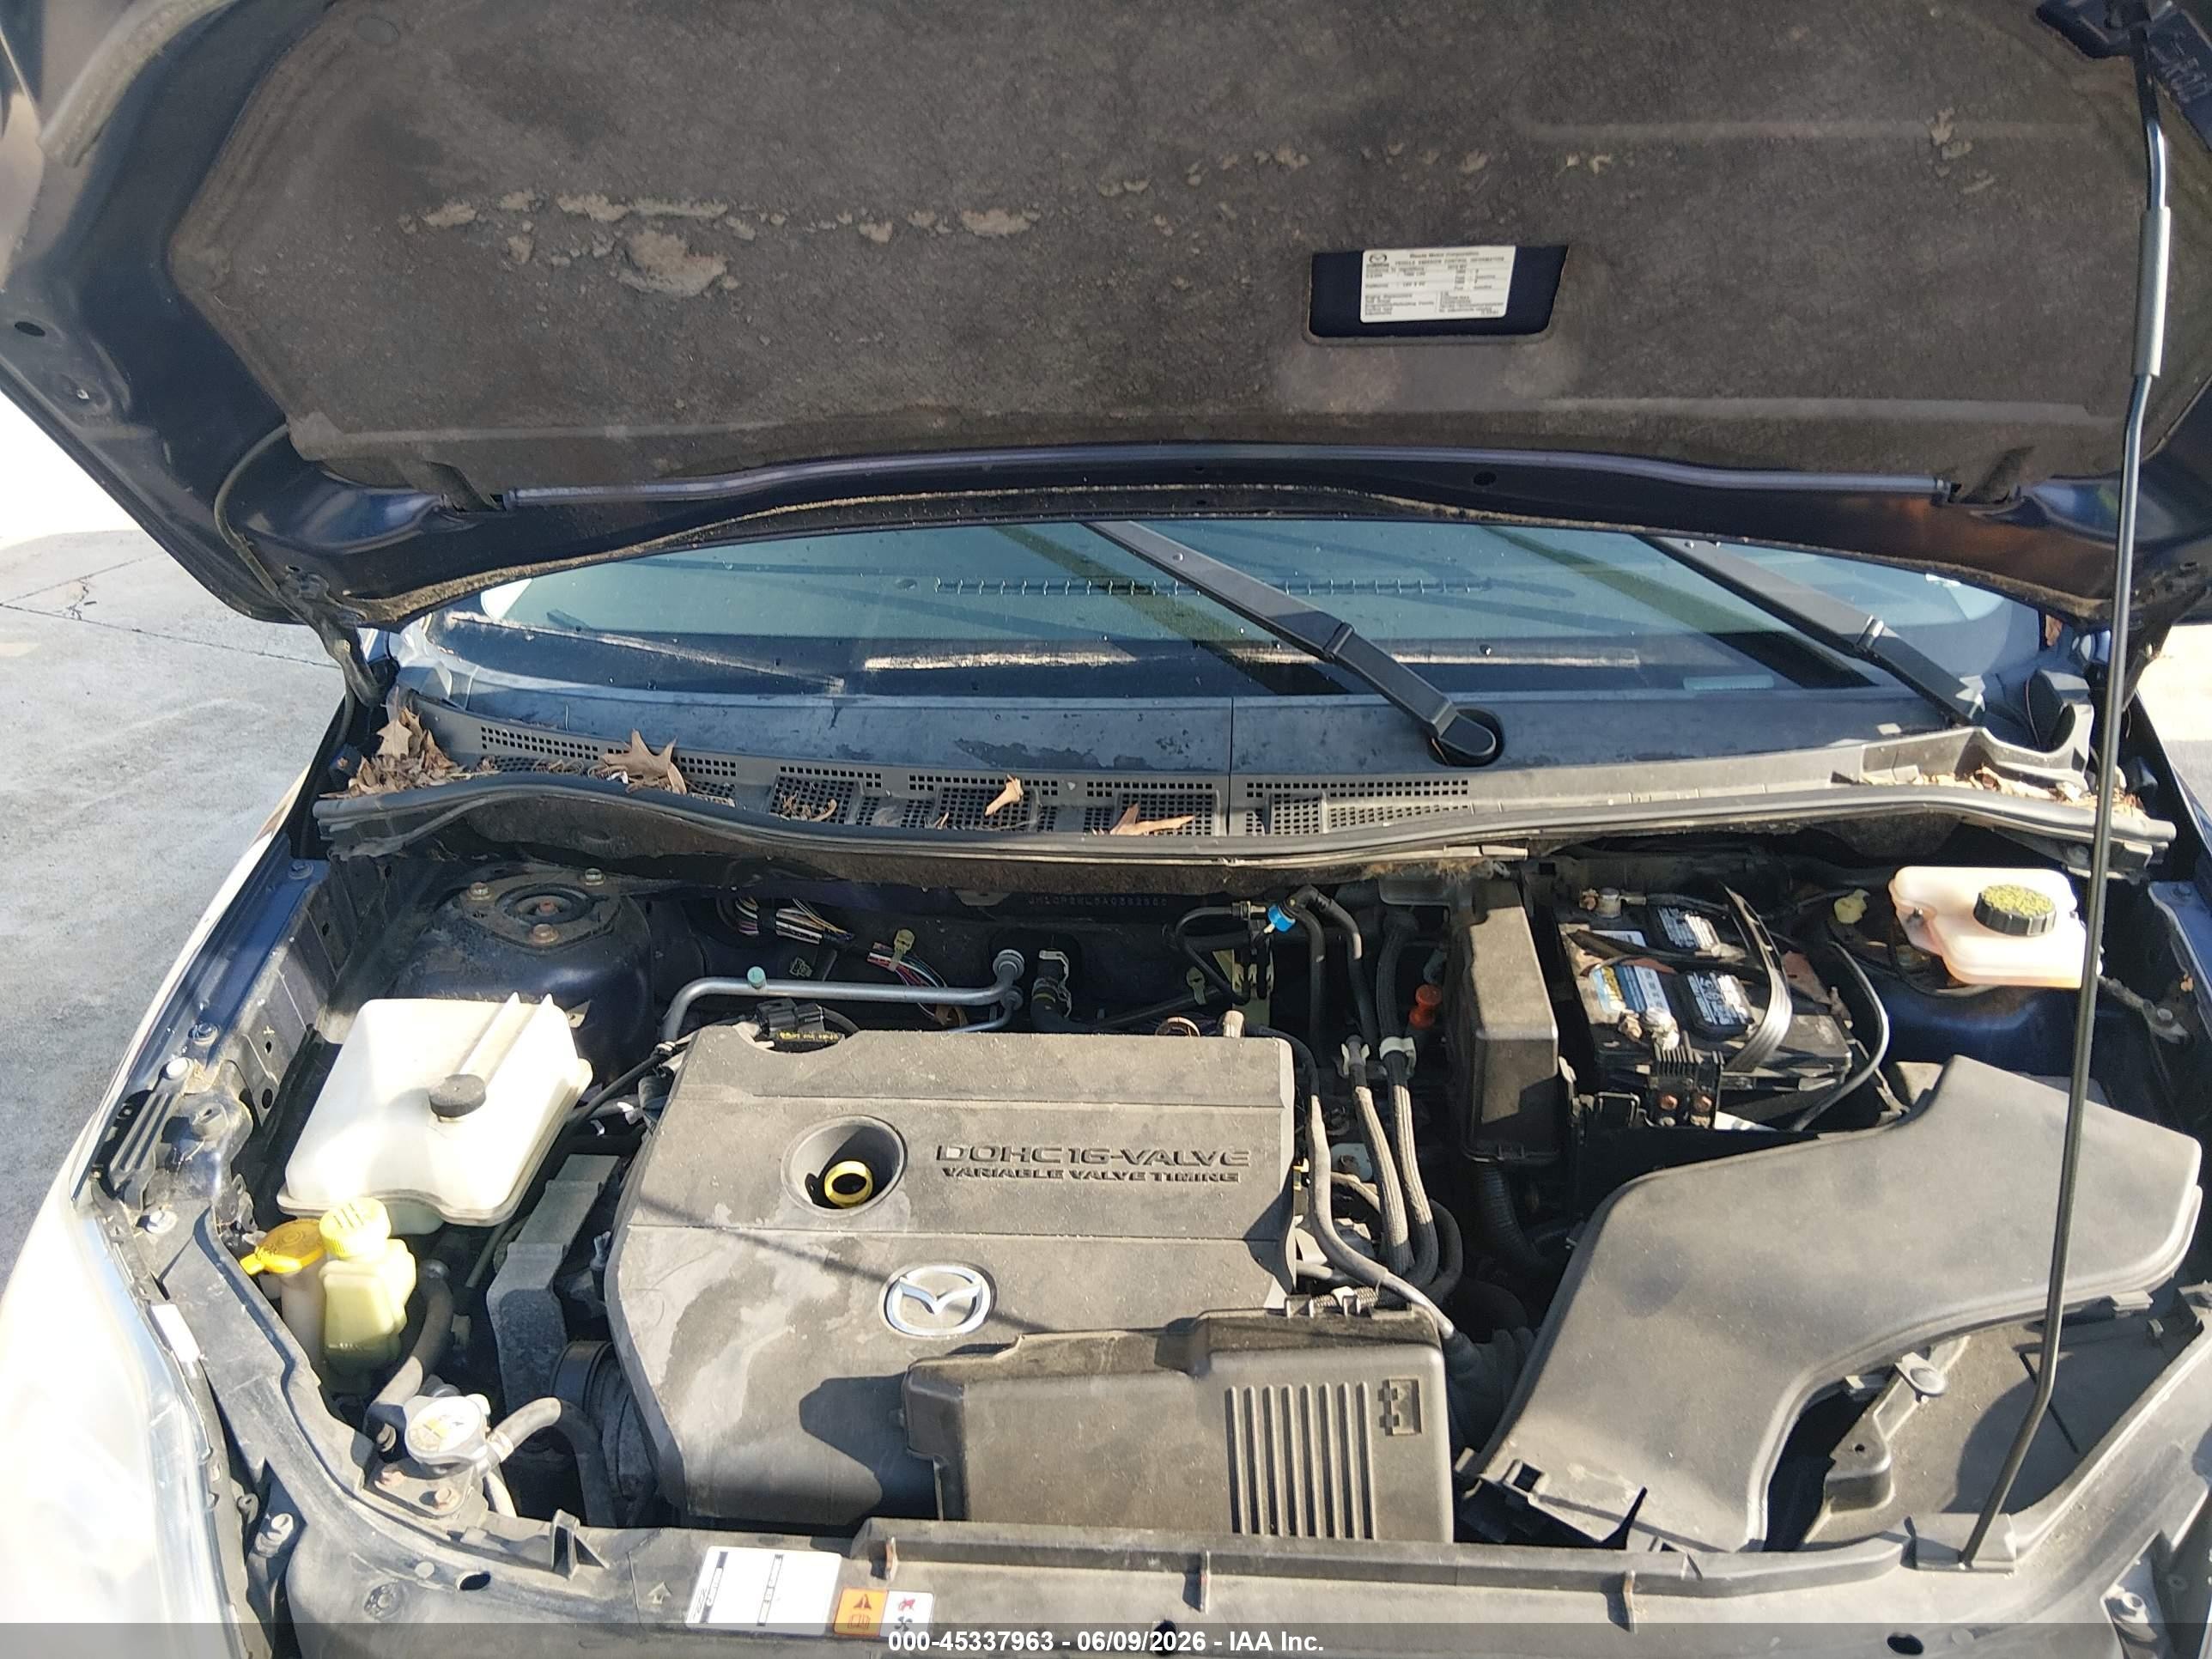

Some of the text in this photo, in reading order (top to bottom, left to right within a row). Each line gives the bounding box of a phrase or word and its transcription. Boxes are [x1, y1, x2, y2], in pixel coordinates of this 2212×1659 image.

[936, 1146, 1250, 1166] DOHC 16-VALVE
[942, 1167, 1240, 1182] VARIABLE VALVE TIMING
